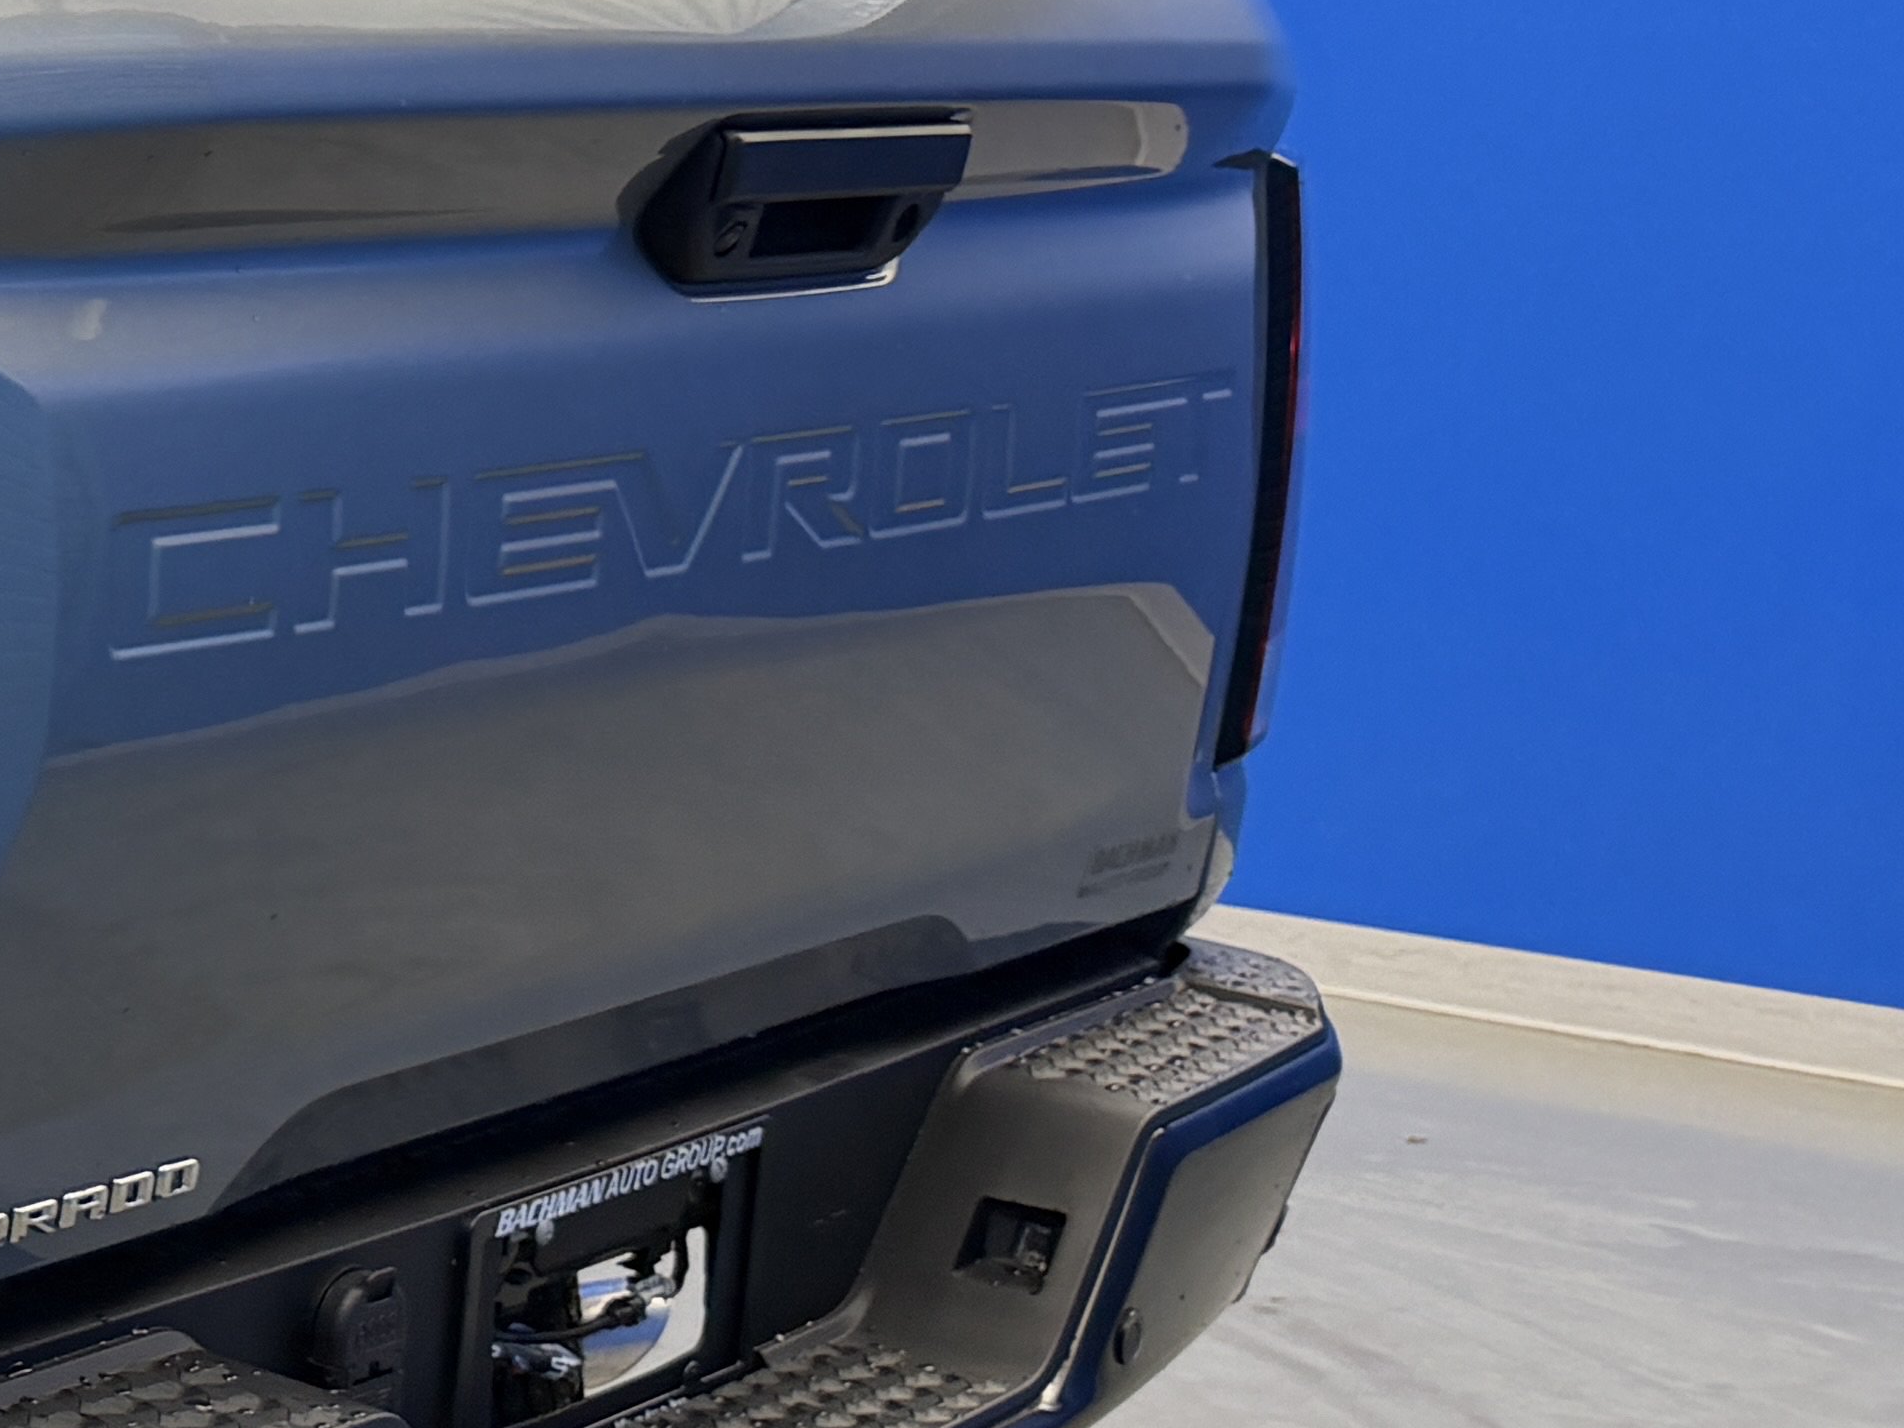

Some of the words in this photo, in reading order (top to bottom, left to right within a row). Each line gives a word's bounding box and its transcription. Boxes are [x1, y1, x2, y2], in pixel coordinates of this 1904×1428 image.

[110, 369, 1234, 659] CHEVROLET
[494, 1175, 608, 1238] BACHMAN
[604, 1158, 659, 1200] AUTO
